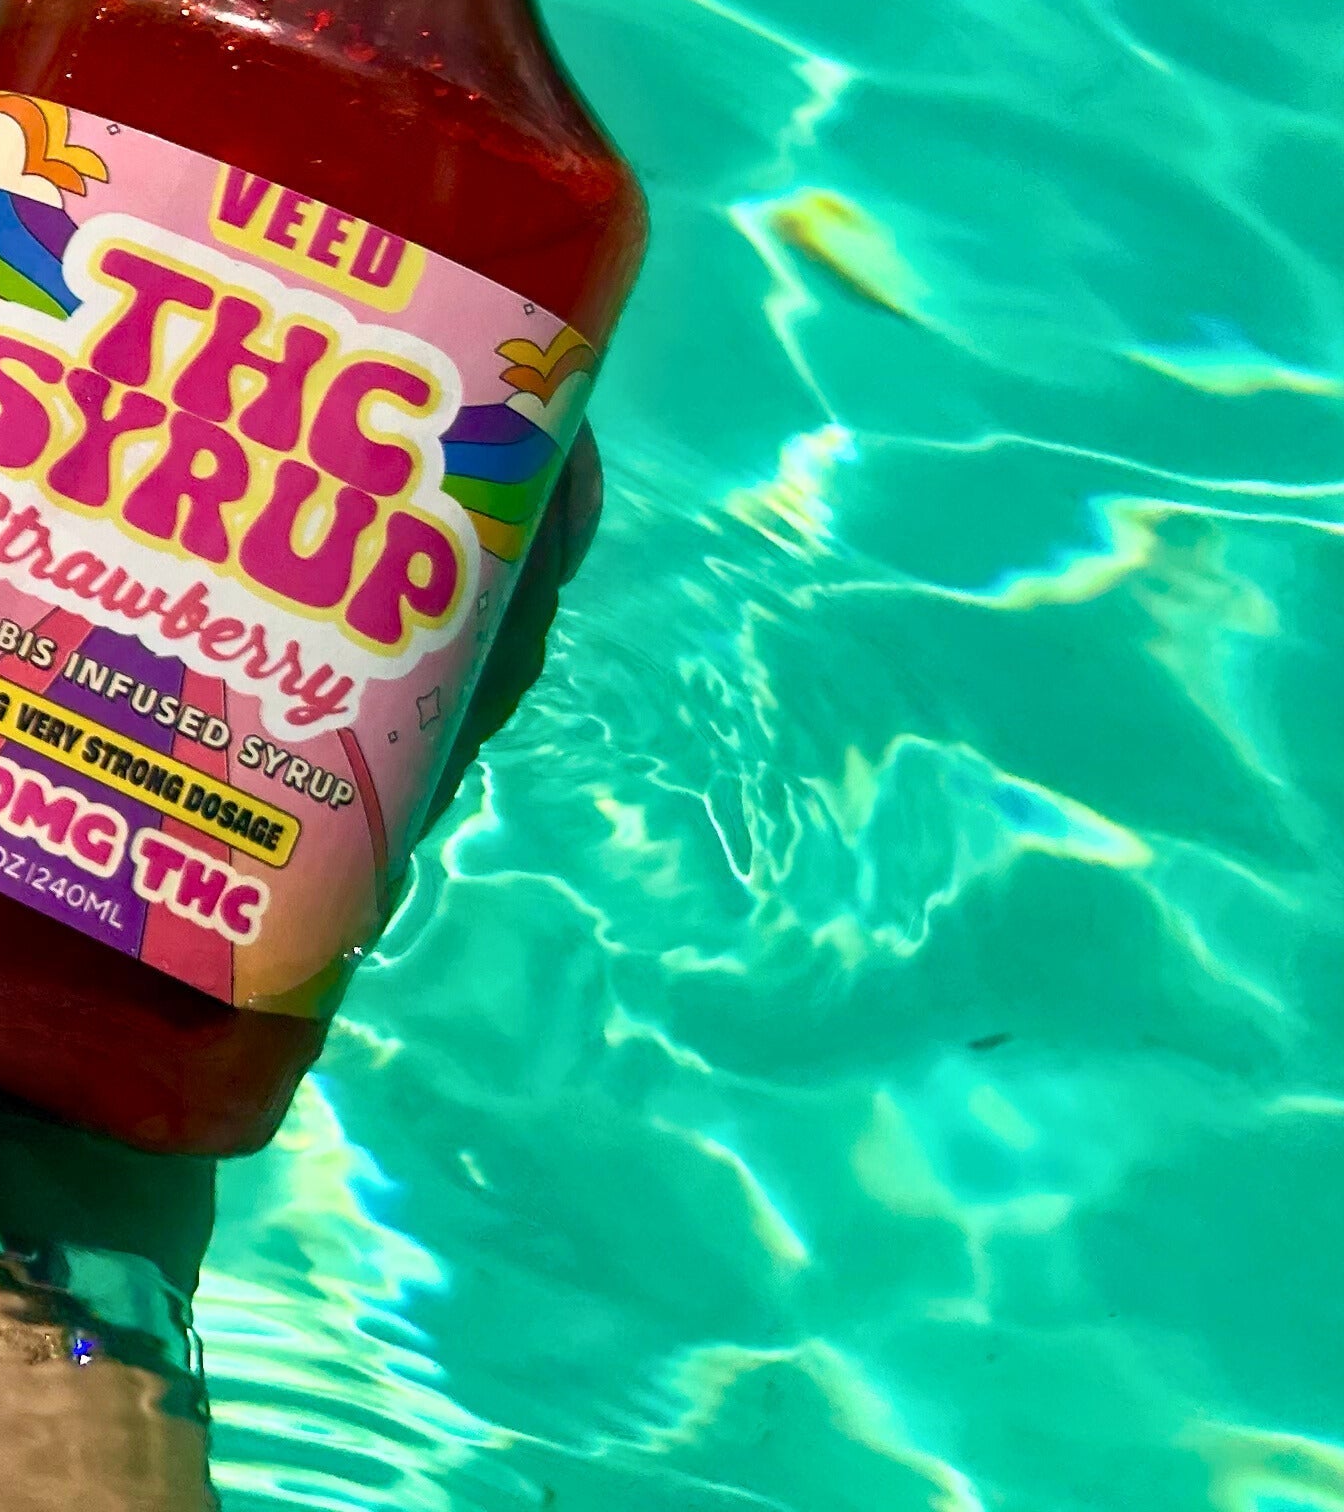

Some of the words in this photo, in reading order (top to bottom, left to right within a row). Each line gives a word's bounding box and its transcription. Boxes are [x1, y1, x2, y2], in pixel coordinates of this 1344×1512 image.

[217, 166, 407, 288] VEED
[89, 248, 431, 497] THC
[16, 698, 87, 755] VERY
[80, 737, 185, 805] STRONG
[183, 782, 286, 852] DOSAGE
[63, 651, 232, 750] INFUSED
[238, 736, 356, 809] SYRUP
[139, 839, 261, 935] THC
